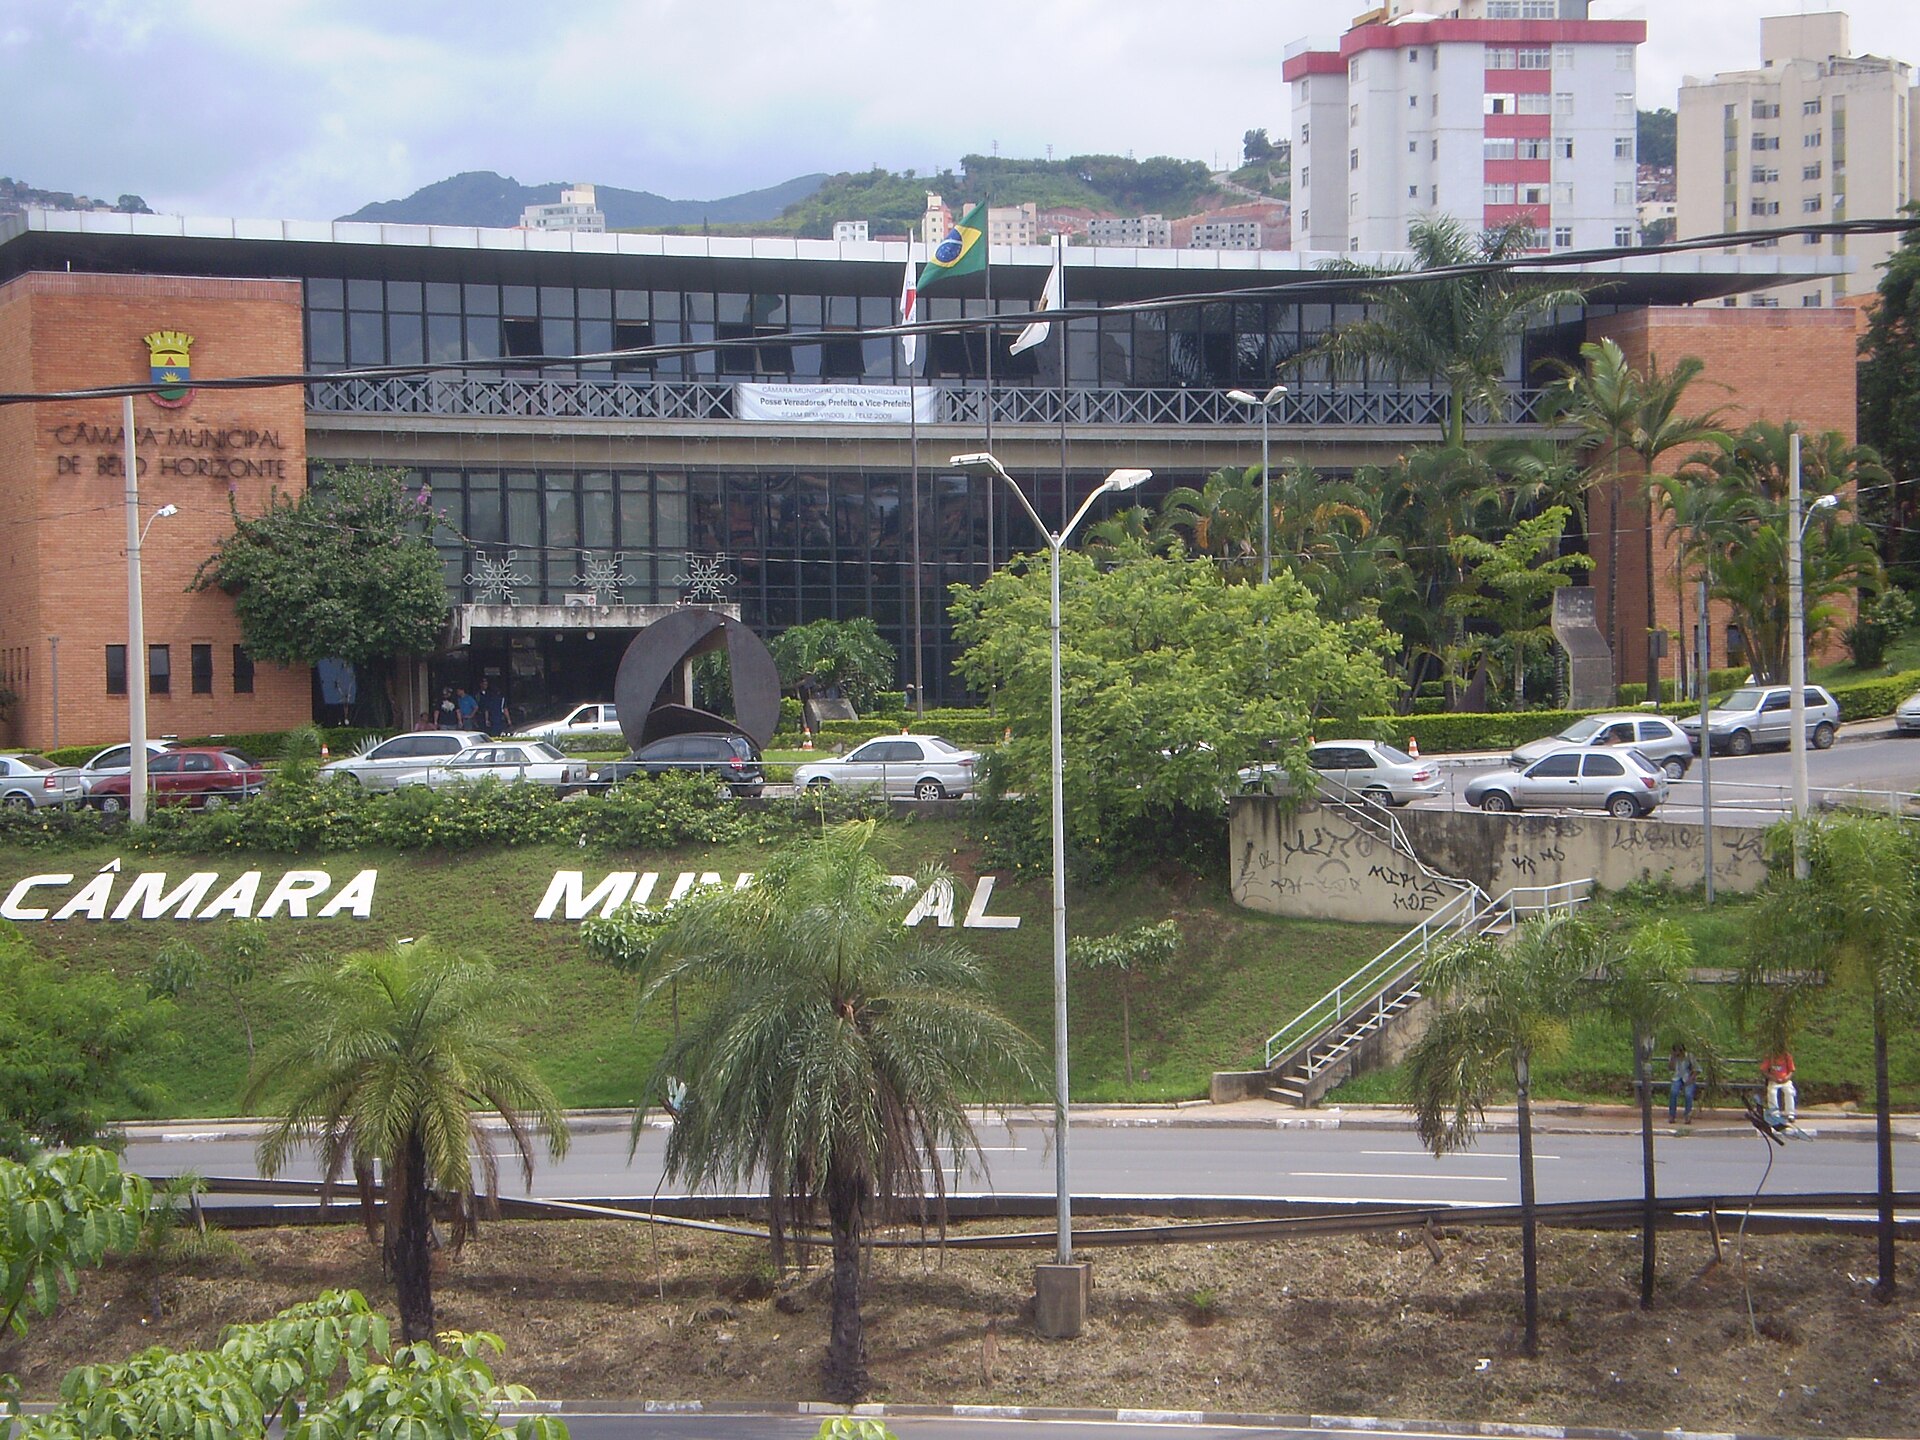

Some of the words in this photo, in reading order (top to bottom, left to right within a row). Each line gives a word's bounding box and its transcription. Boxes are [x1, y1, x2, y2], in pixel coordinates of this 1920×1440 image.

[762, 385, 793, 393] CÂMARA
[760, 397, 781, 405] Posse
[784, 398, 826, 407] Vereadores,
[829, 399, 858, 407] Prefeito
[866, 400, 912, 408] Vice-Prefeito
[55, 421, 158, 447] CÂMARA
[167, 427, 286, 450] MUNICIPAL
[57, 455, 81, 475] DE
[97, 456, 147, 477] BELO
[160, 457, 287, 479] HORIZONTE
[0, 857, 378, 921] CÂMARA
